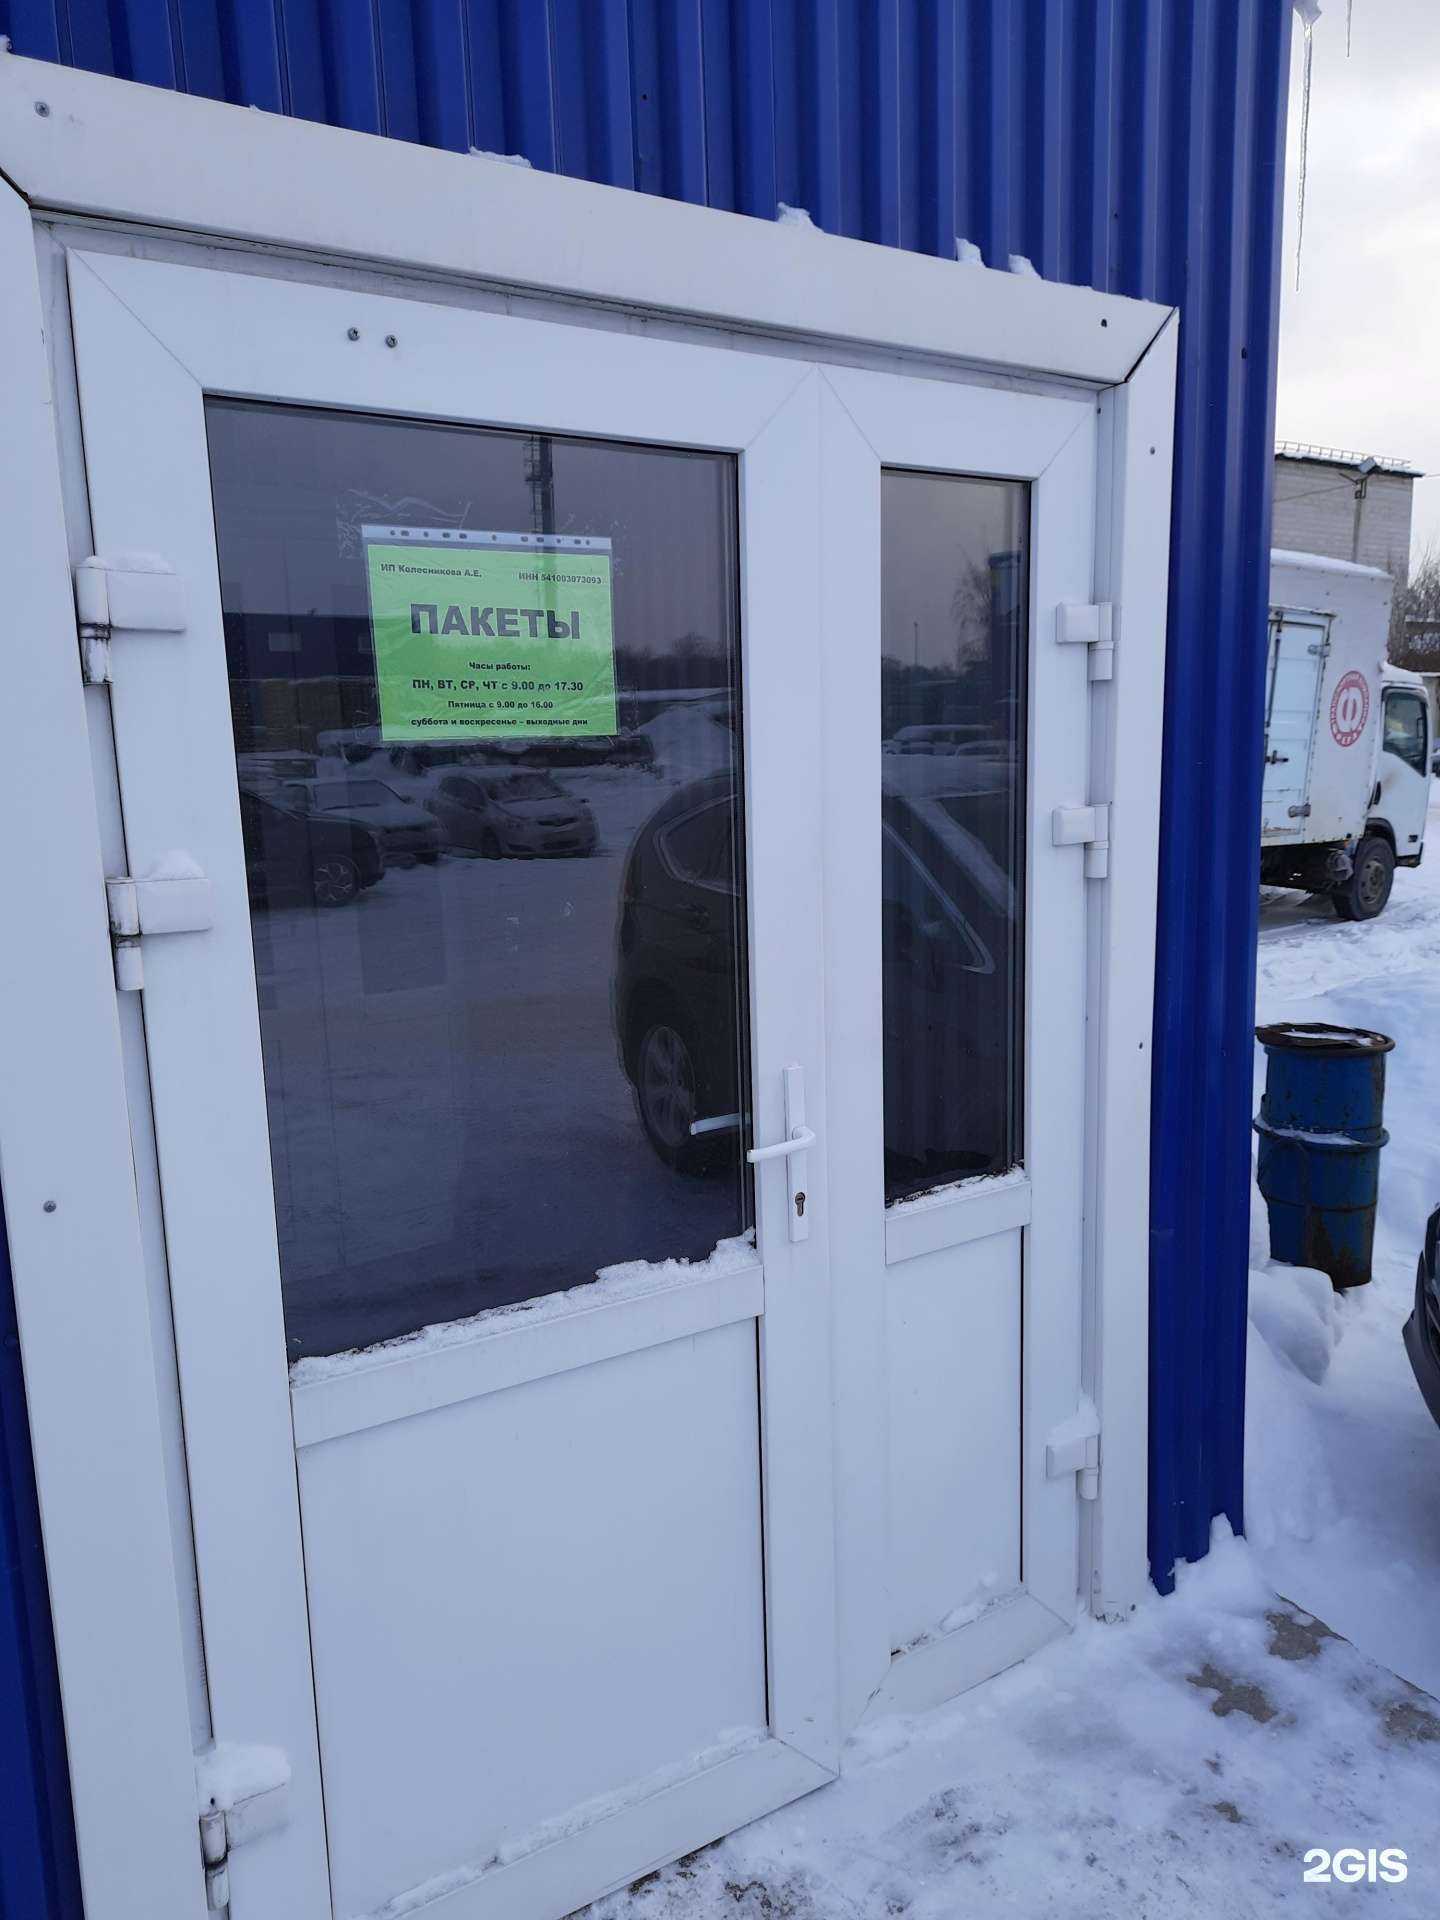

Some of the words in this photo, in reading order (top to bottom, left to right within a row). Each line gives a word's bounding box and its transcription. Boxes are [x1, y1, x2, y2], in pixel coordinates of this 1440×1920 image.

[381, 563, 396, 572] ИП
[398, 565, 462, 576] Колесникова
[464, 569, 483, 577] А.Е.
[410, 604, 580, 639] ПАКЕТЫ
[469, 661, 494, 670] Часы
[496, 663, 531, 671] работы:
[412, 679, 434, 690] ПН,
[437, 680, 457, 691] ВТ,
[460, 680, 479, 691] СР,
[483, 681, 498, 690] ЧТ
[512, 681, 535, 690] 9.00
[537, 683, 551, 691] до
[554, 681, 584, 691] 17.30
[448, 700, 486, 709] Пятница
[496, 701, 515, 709] 9.00
[411, 718, 448, 727] суббота
